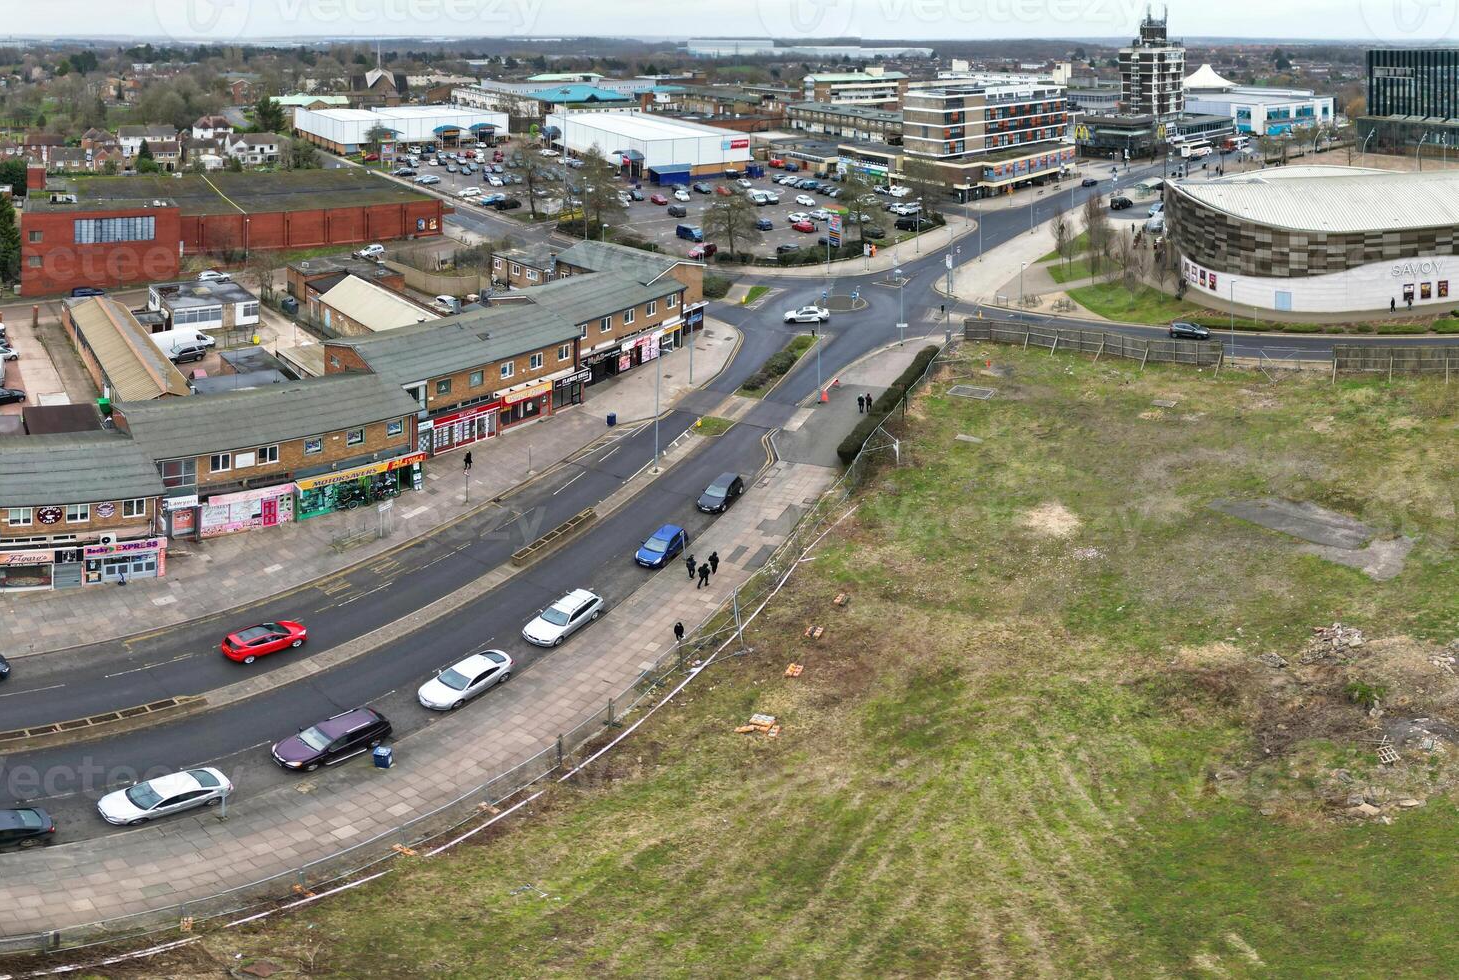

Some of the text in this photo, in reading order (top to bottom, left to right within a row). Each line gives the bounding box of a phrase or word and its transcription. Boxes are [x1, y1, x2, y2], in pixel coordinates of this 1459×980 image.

[1392, 261, 1442, 276] SAVOY
[313, 468, 377, 487] MOTORSAVERS
[116, 541, 158, 550] EXPRESS
